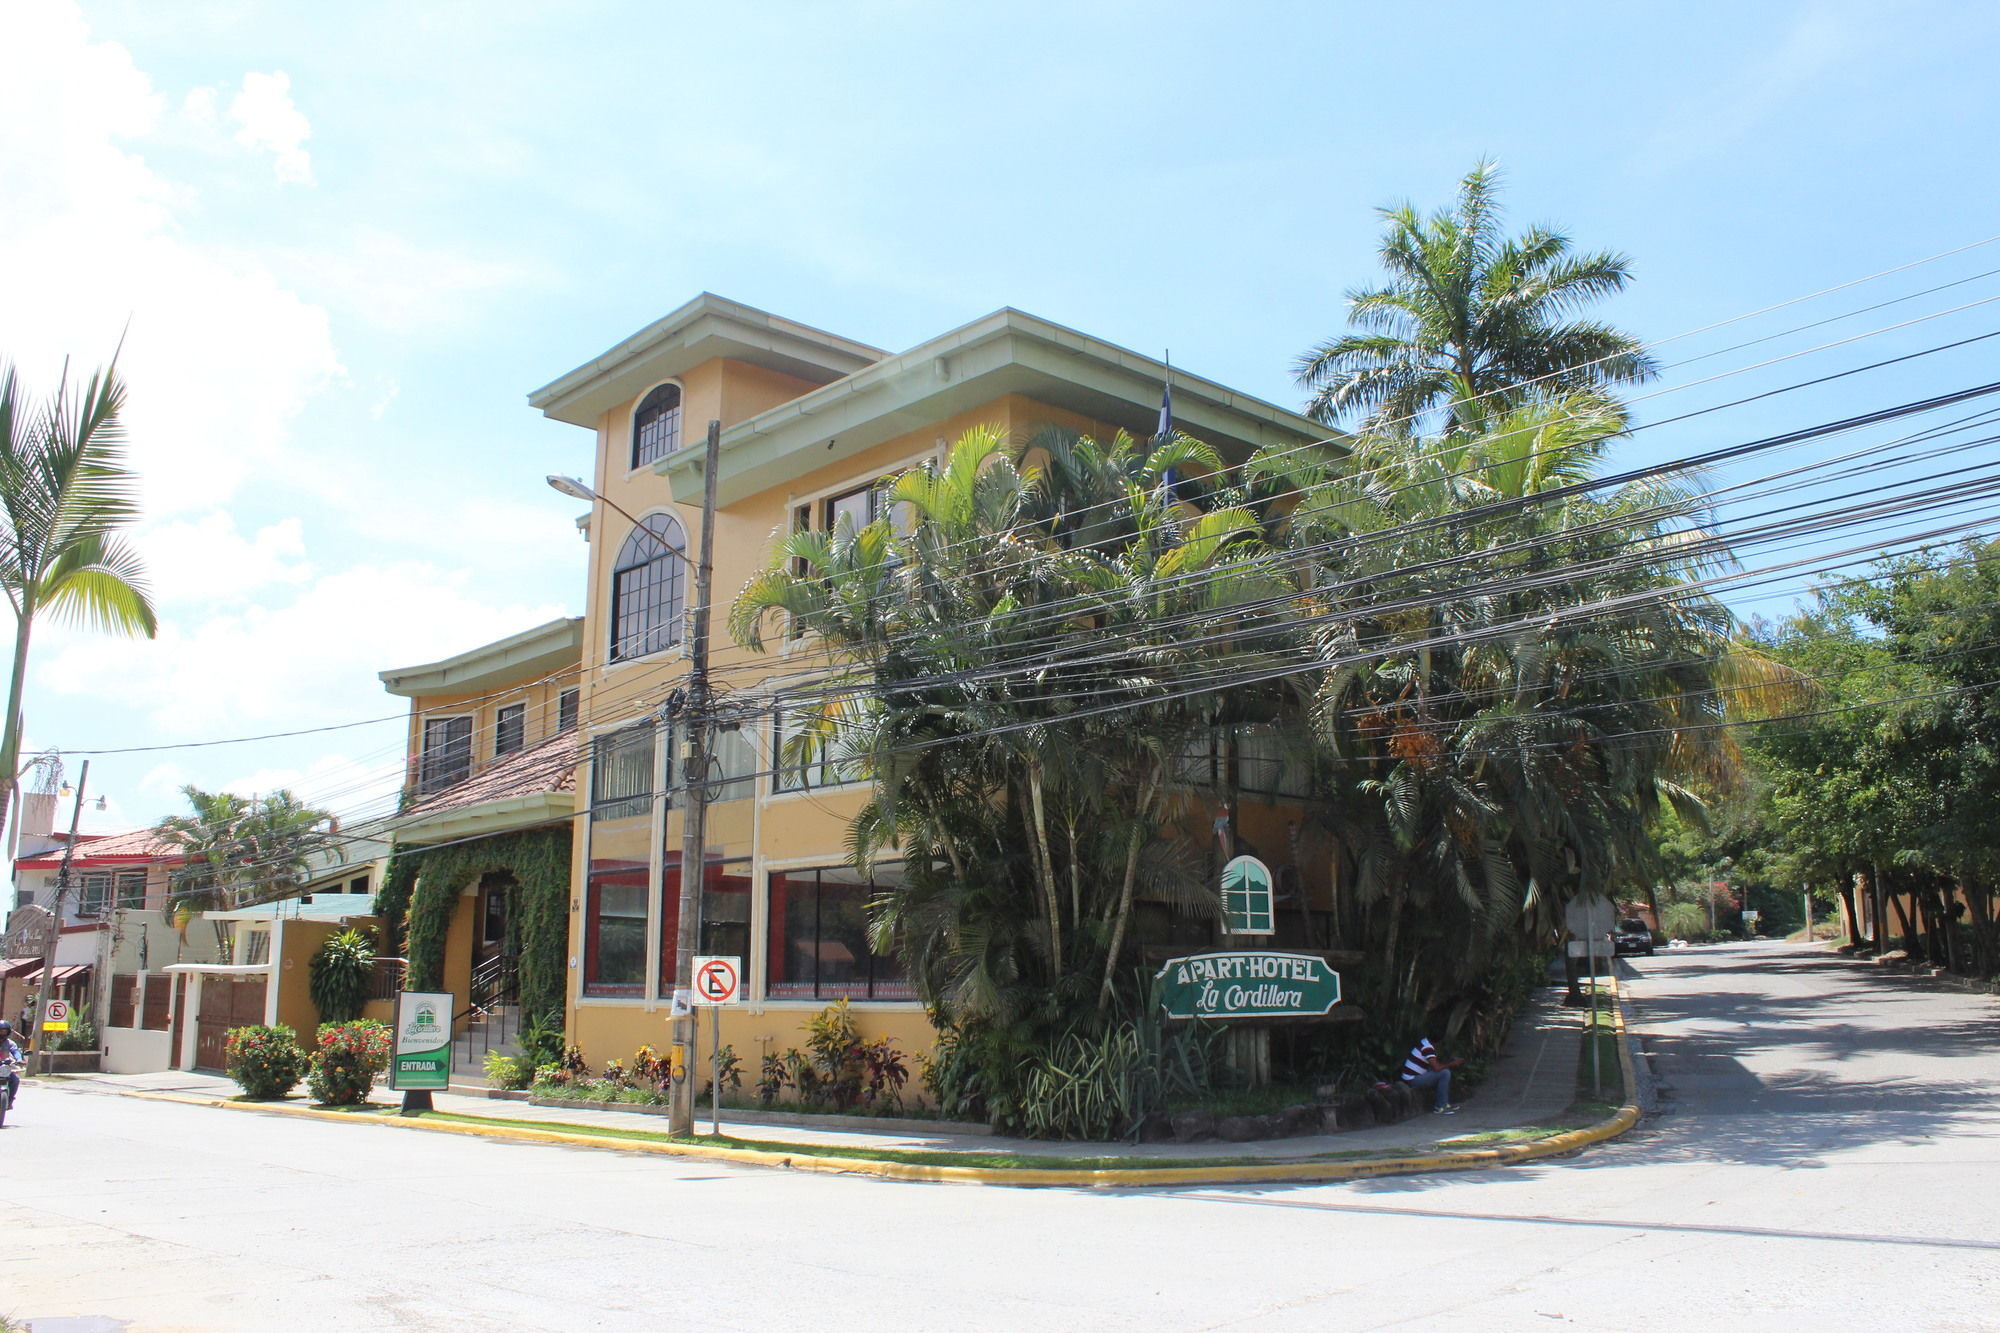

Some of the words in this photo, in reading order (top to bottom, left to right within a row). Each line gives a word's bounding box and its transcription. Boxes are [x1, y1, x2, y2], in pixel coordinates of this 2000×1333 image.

[1196, 980, 1220, 1012] La
[1224, 984, 1303, 1010] Cordillera
[401, 1061, 436, 1071] ENTRADA
